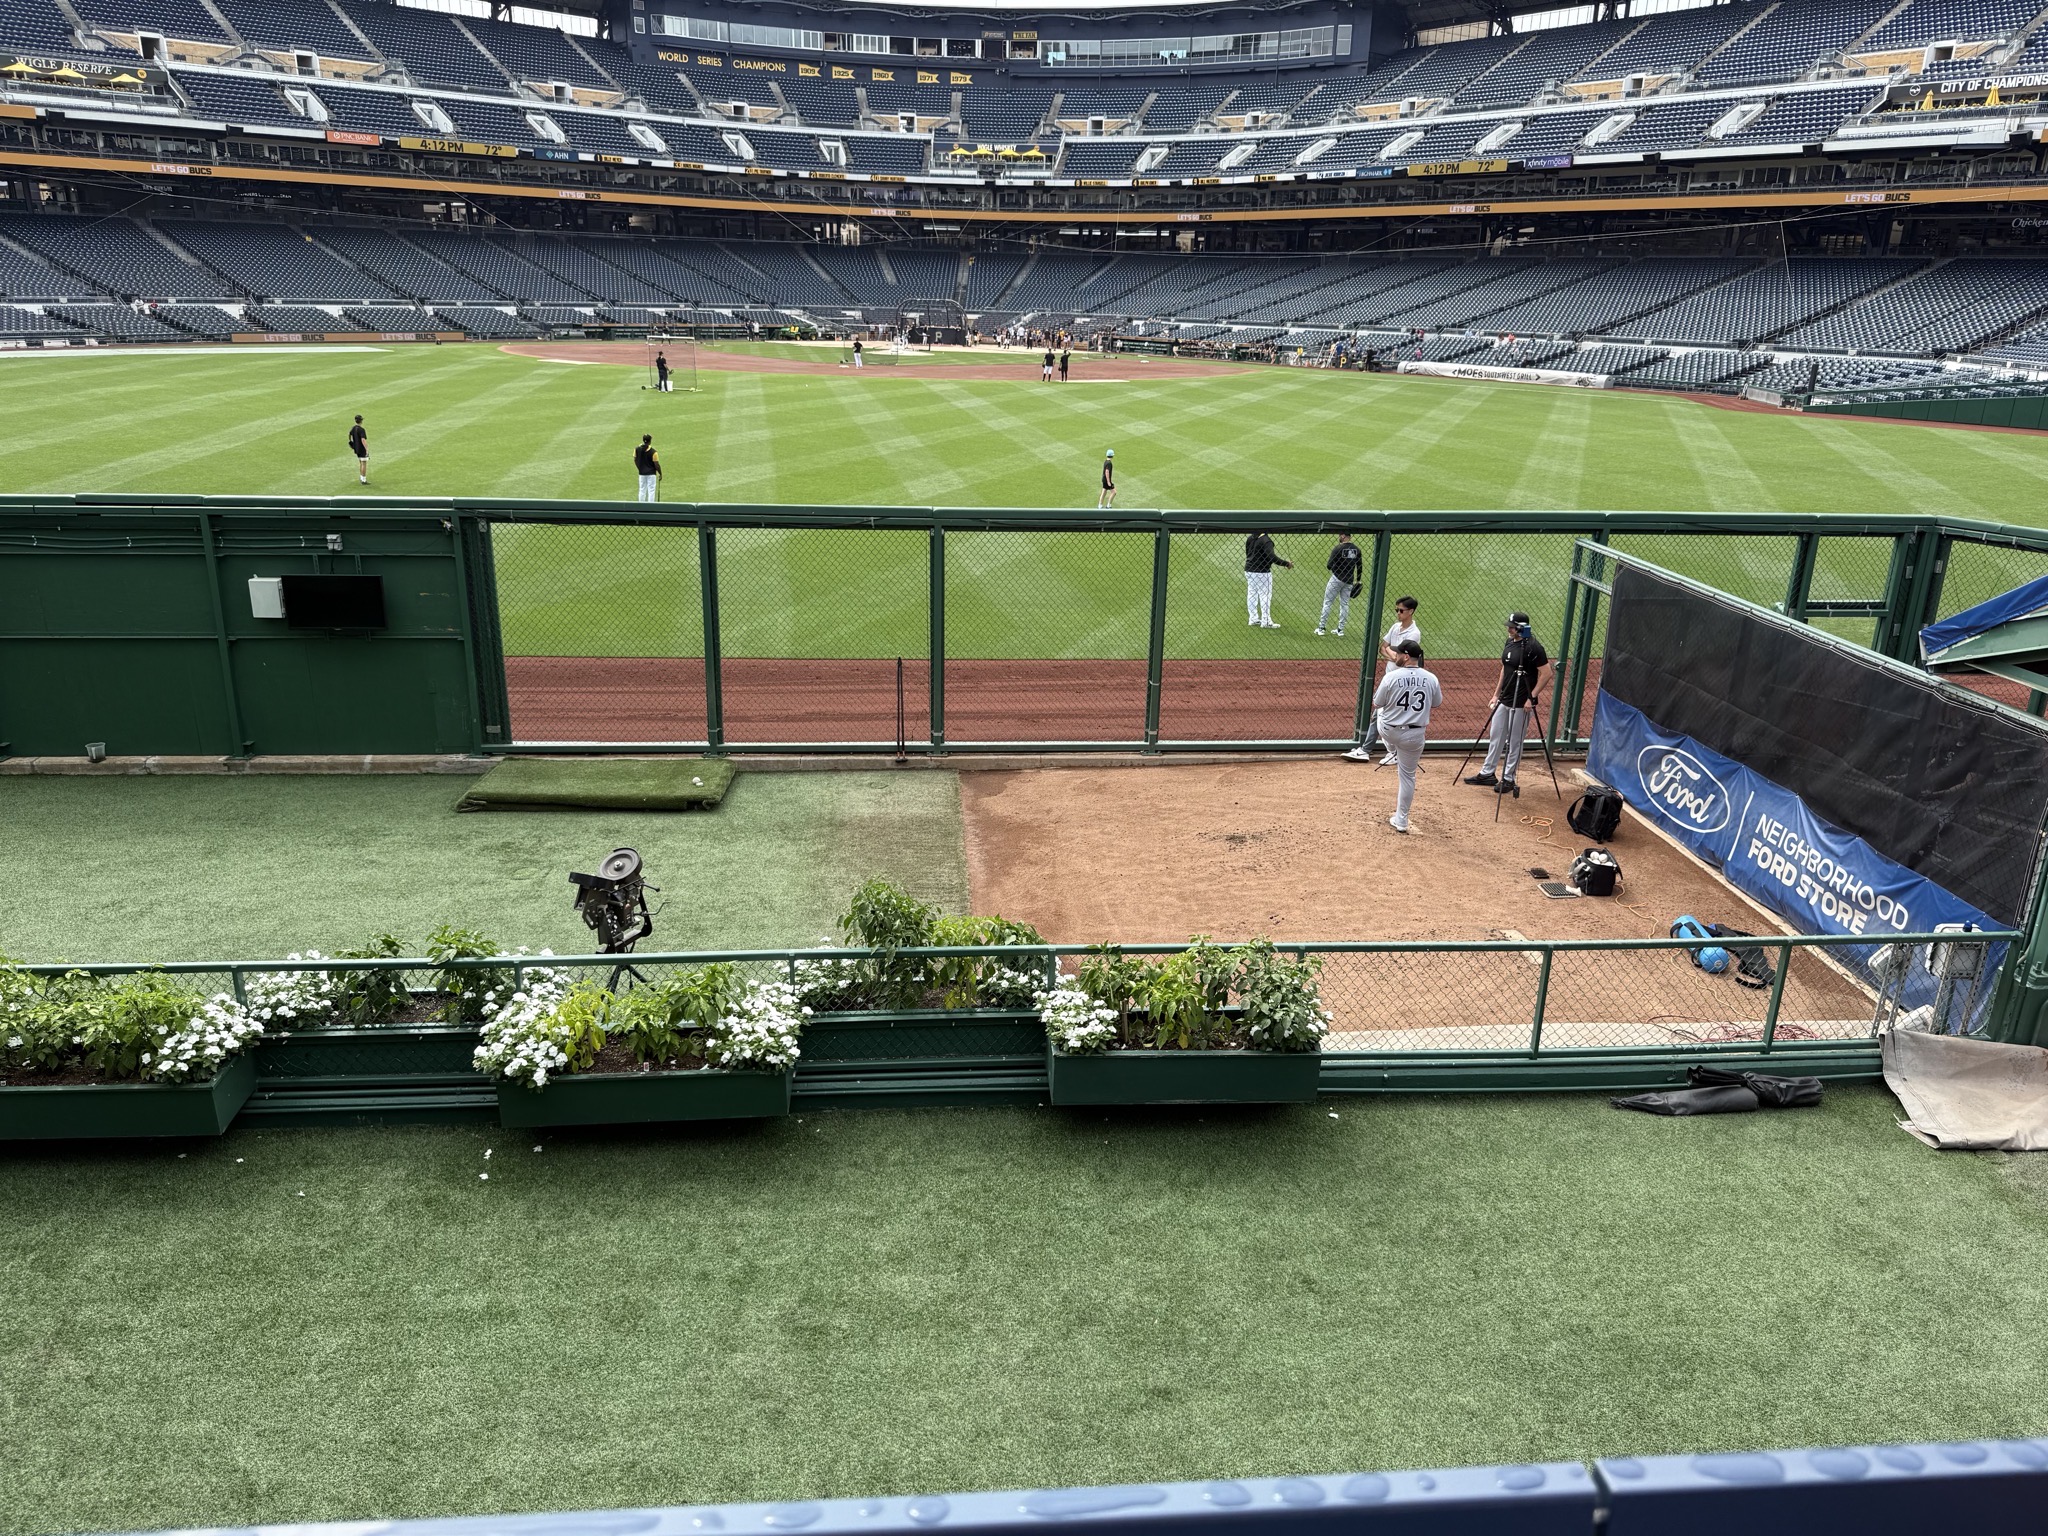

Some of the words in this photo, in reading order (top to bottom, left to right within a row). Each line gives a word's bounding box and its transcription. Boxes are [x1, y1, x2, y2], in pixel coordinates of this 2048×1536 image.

[657, 50, 689, 64] WORLD
[697, 55, 722, 68] SERIES
[733, 59, 786, 73] CHAMPIONS
[62, 61, 113, 75] RESERVE
[800, 67, 816, 76] 1909
[833, 69, 850, 78] 1925
[874, 72, 890, 80] 1960
[919, 74, 934, 82] 1971
[951, 75, 967, 83] 1979
[1940, 81, 1965, 93] CITY
[1967, 80, 1982, 92] OF
[1984, 74, 2048, 90] CHAMPIONS
[420, 139, 446, 151] 4:12
[447, 142, 464, 153] PM
[554, 151, 569, 160] AHN
[1528, 158, 1547, 168] xfinity
[151, 163, 176, 173] LET'S
[189, 167, 212, 176] BUCS
[1423, 165, 1443, 175] 4:12
[1444, 163, 1460, 174] PM
[1845, 194, 1870, 203] LET'S
[1885, 192, 1911, 202] BUCS
[264, 334, 289, 342] LET'S
[301, 334, 325, 342] BUCS
[381, 333, 404, 341] LET'S
[415, 333, 437, 341] BUCS
[1516, 372, 1532, 381] GRILL
[1397, 676, 1428, 688] CIVALE
[1396, 690, 1426, 712] 43
[1650, 753, 1716, 823] Ford
[1754, 813, 1909, 931] NEIGHBORHOOD
[1747, 839, 1796, 887] FORD
[1795, 874, 1868, 936] STORE
